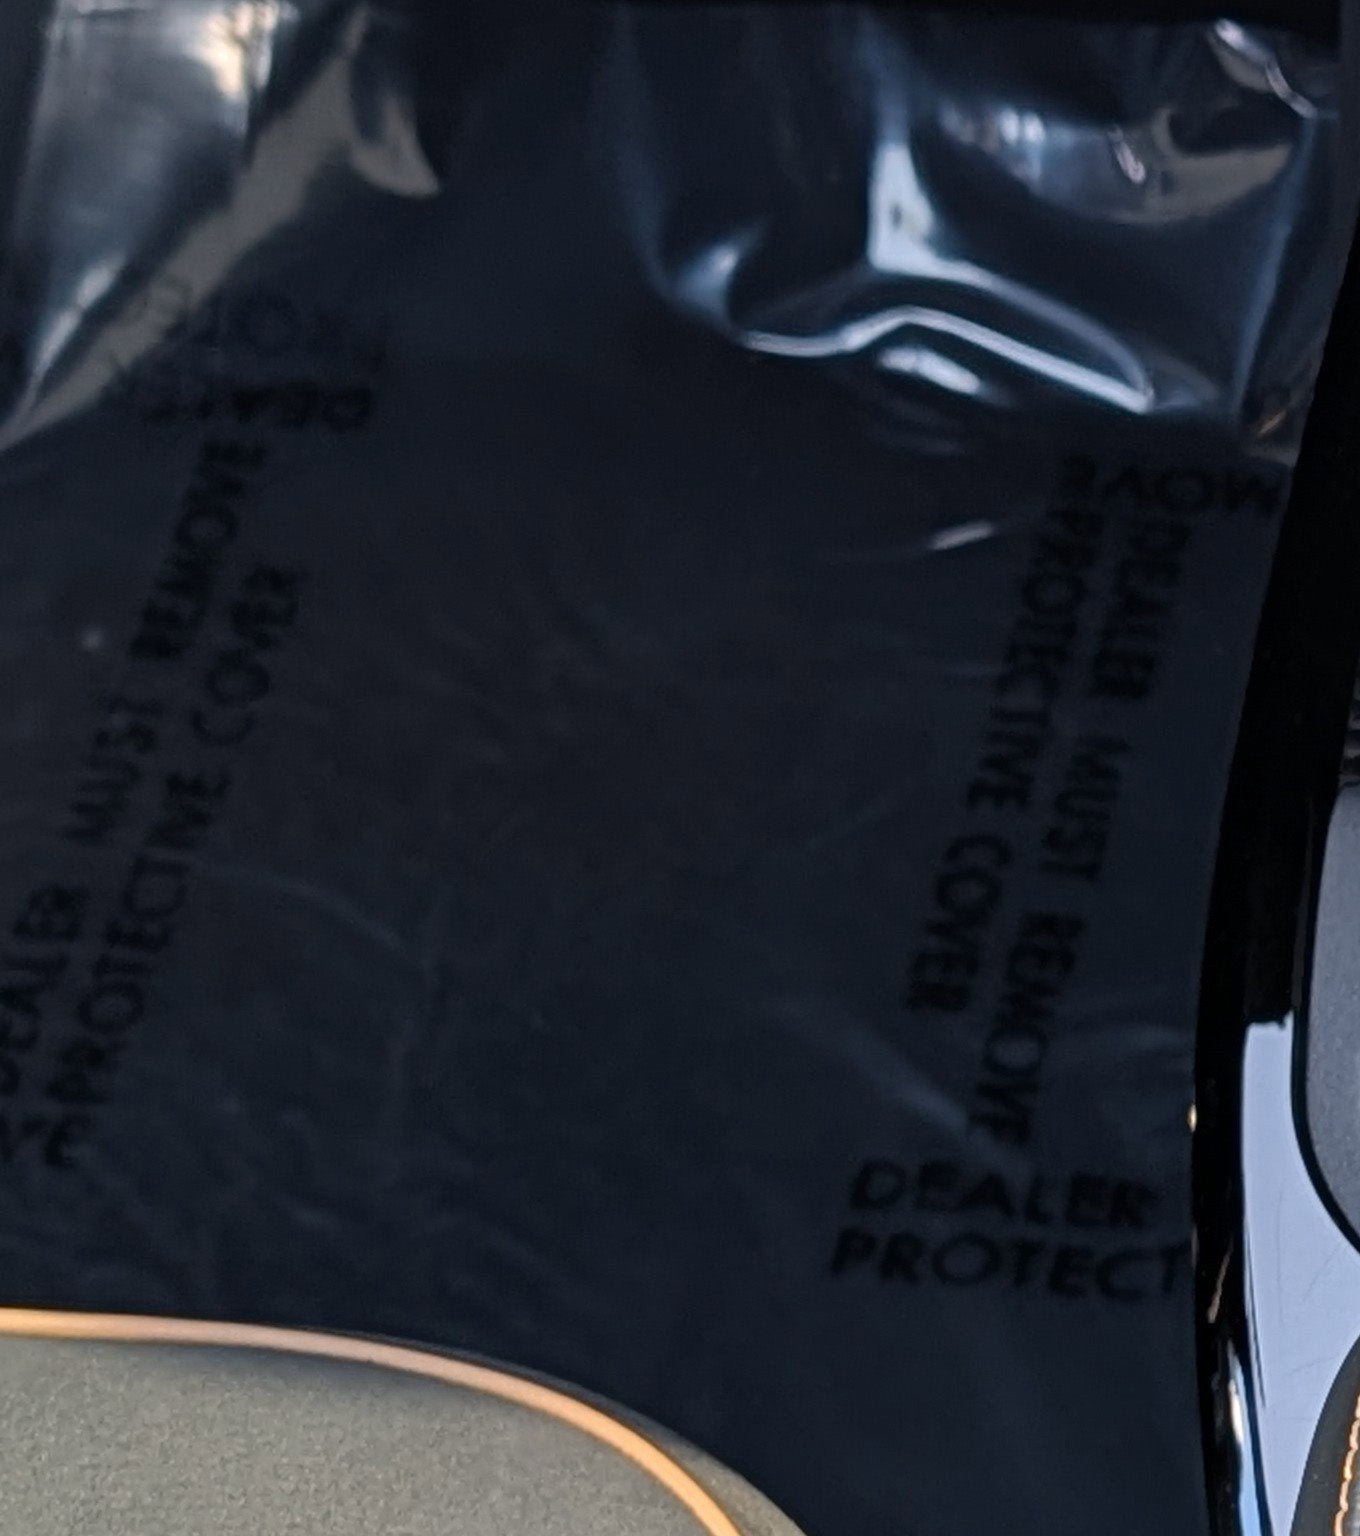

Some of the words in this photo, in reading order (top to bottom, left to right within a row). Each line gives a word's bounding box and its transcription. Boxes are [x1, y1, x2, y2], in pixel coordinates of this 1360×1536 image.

[1091, 522, 1192, 699] DEALER
[1039, 735, 1130, 880] MUST
[906, 835, 1012, 1011] COVER
[831, 1228, 1192, 1300] PROTECT
[849, 1158, 1158, 1228] DEALER
